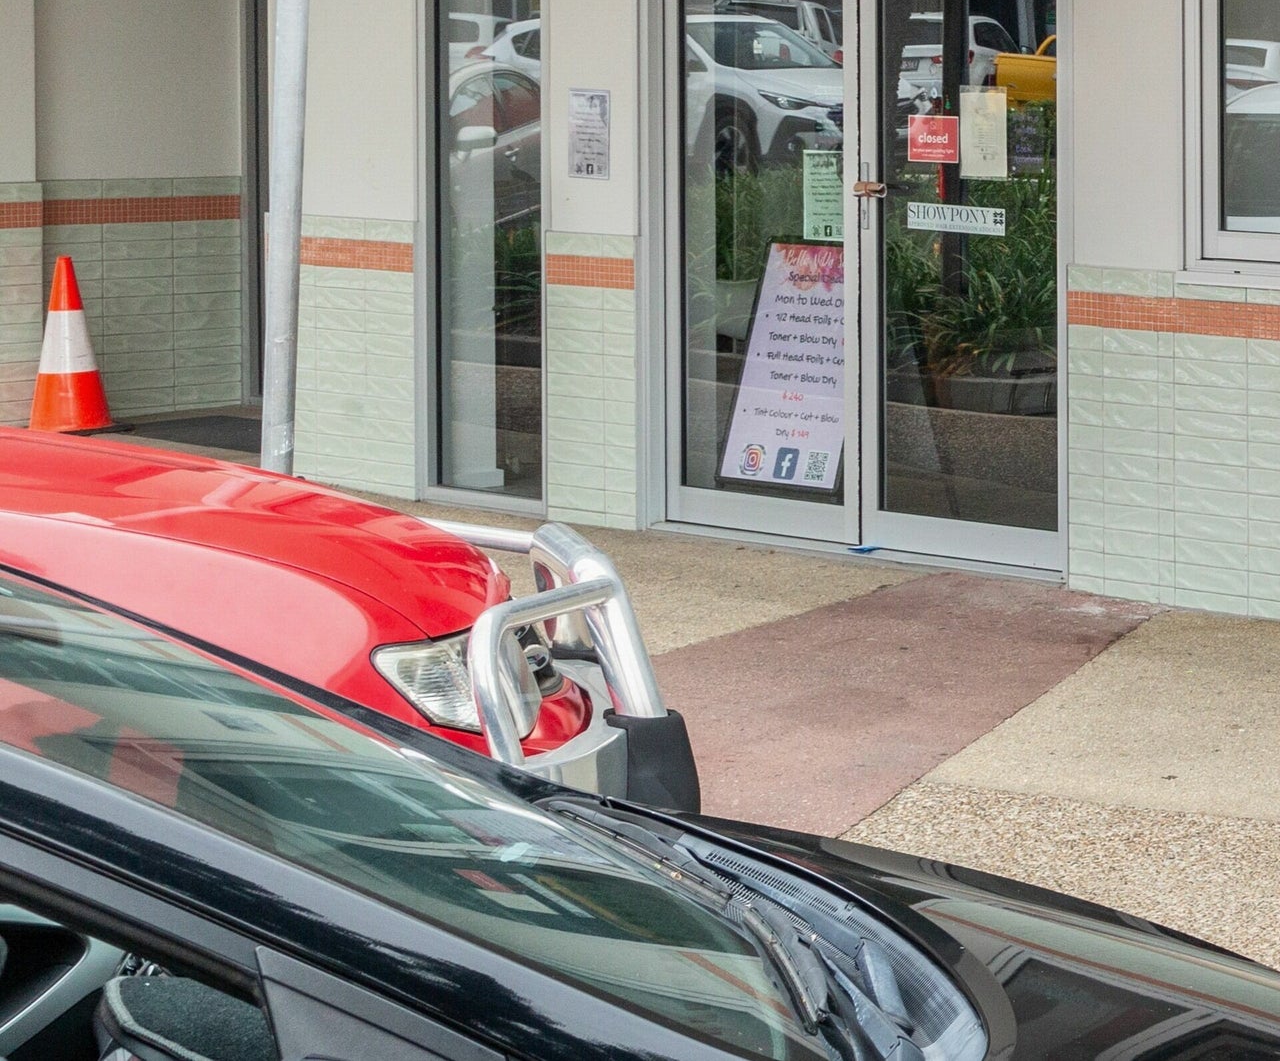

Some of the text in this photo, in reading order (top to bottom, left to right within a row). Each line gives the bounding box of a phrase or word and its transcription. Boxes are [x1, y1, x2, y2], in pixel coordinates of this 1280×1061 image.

[918, 132, 949, 144] closed
[908, 203, 990, 225] SHOWPONY
[788, 271, 820, 285] Special
[774, 294, 795, 305] Mon
[796, 294, 808, 306] to
[810, 297, 833, 307] Wed
[789, 314, 811, 324] Head
[814, 315, 831, 326] Foils
[768, 331, 792, 342] Toner
[800, 334, 820, 344] Blow
[822, 336, 838, 349] Dry
[767, 351, 781, 361] Full
[782, 353, 804, 363] Head
[806, 354, 824, 366] Foils
[769, 370, 793, 381] Toner
[800, 373, 820, 383] Blow
[822, 376, 838, 388] Dry
[754, 407, 768, 417] Tint
[768, 409, 793, 419] Colour
[800, 412, 814, 421] Cut
[820, 415, 839, 424] Blow
[775, 428, 790, 440] Dry
